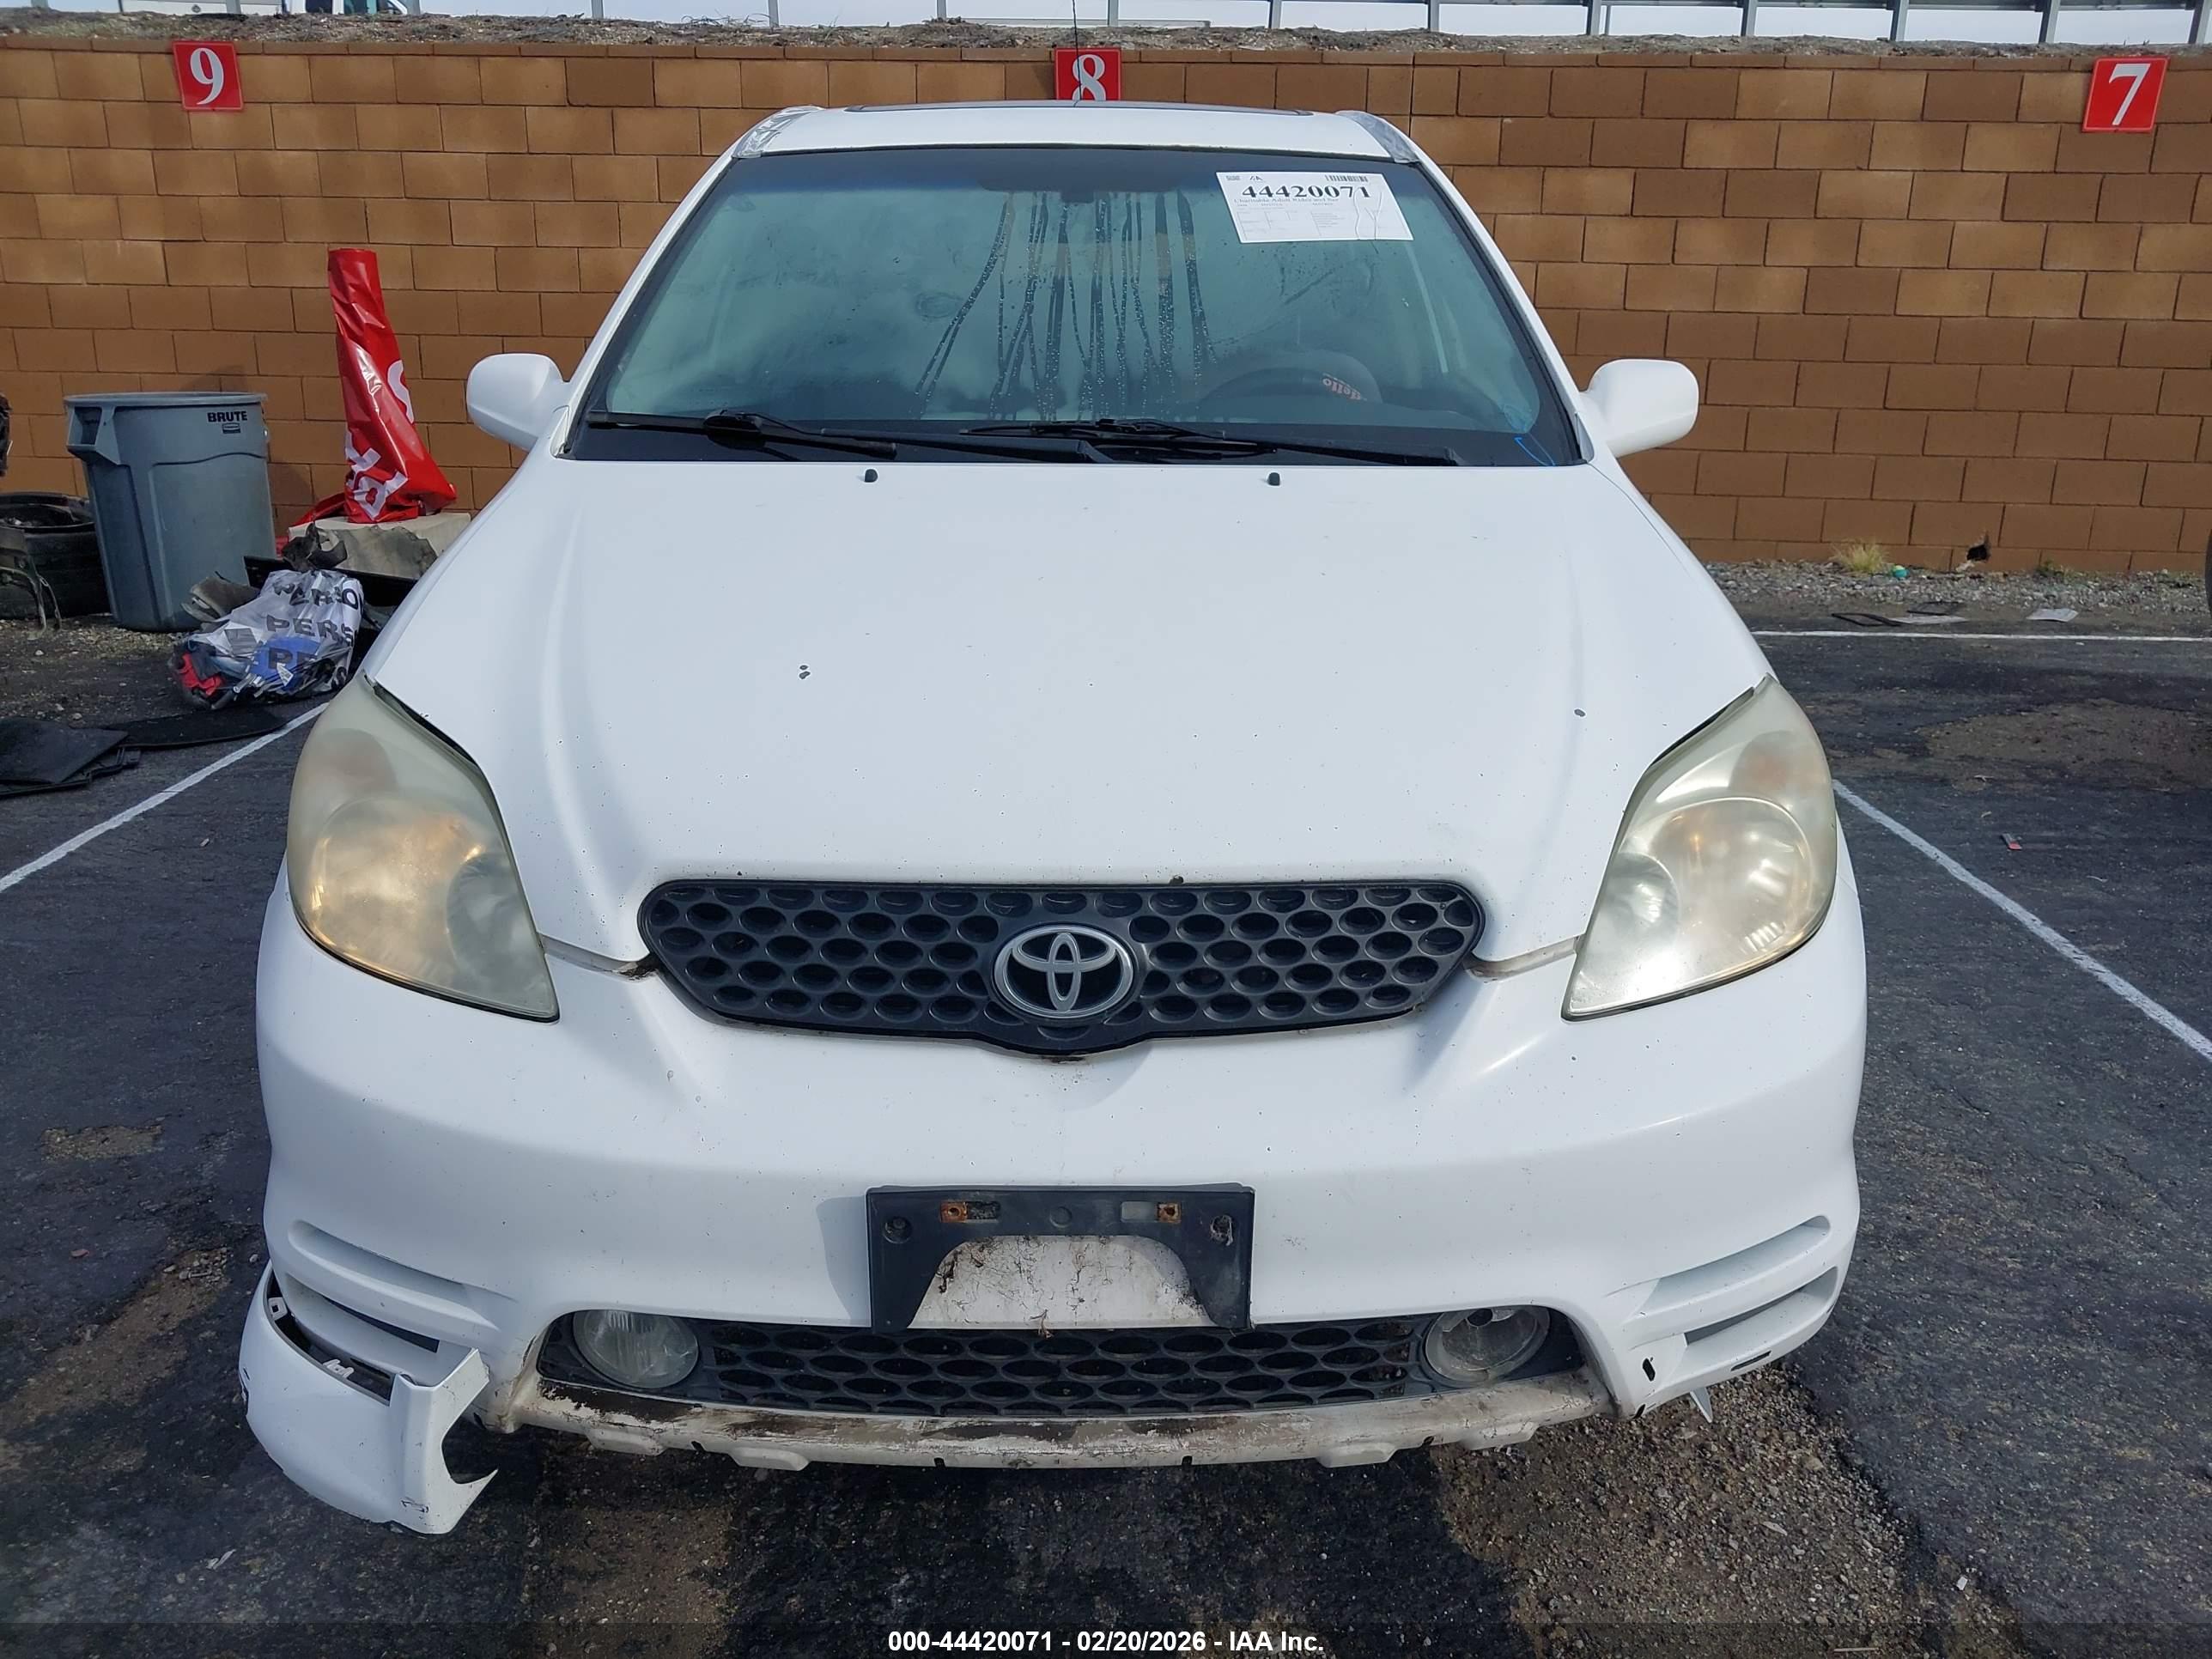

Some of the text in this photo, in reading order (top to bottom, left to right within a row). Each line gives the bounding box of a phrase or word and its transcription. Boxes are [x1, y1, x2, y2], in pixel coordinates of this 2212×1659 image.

[190, 47, 224, 105] 9
[1072, 53, 1106, 100] 8
[2108, 63, 2151, 125] 7
[1242, 185, 1371, 198] 44420071
[207, 410, 248, 422] BRUTE
